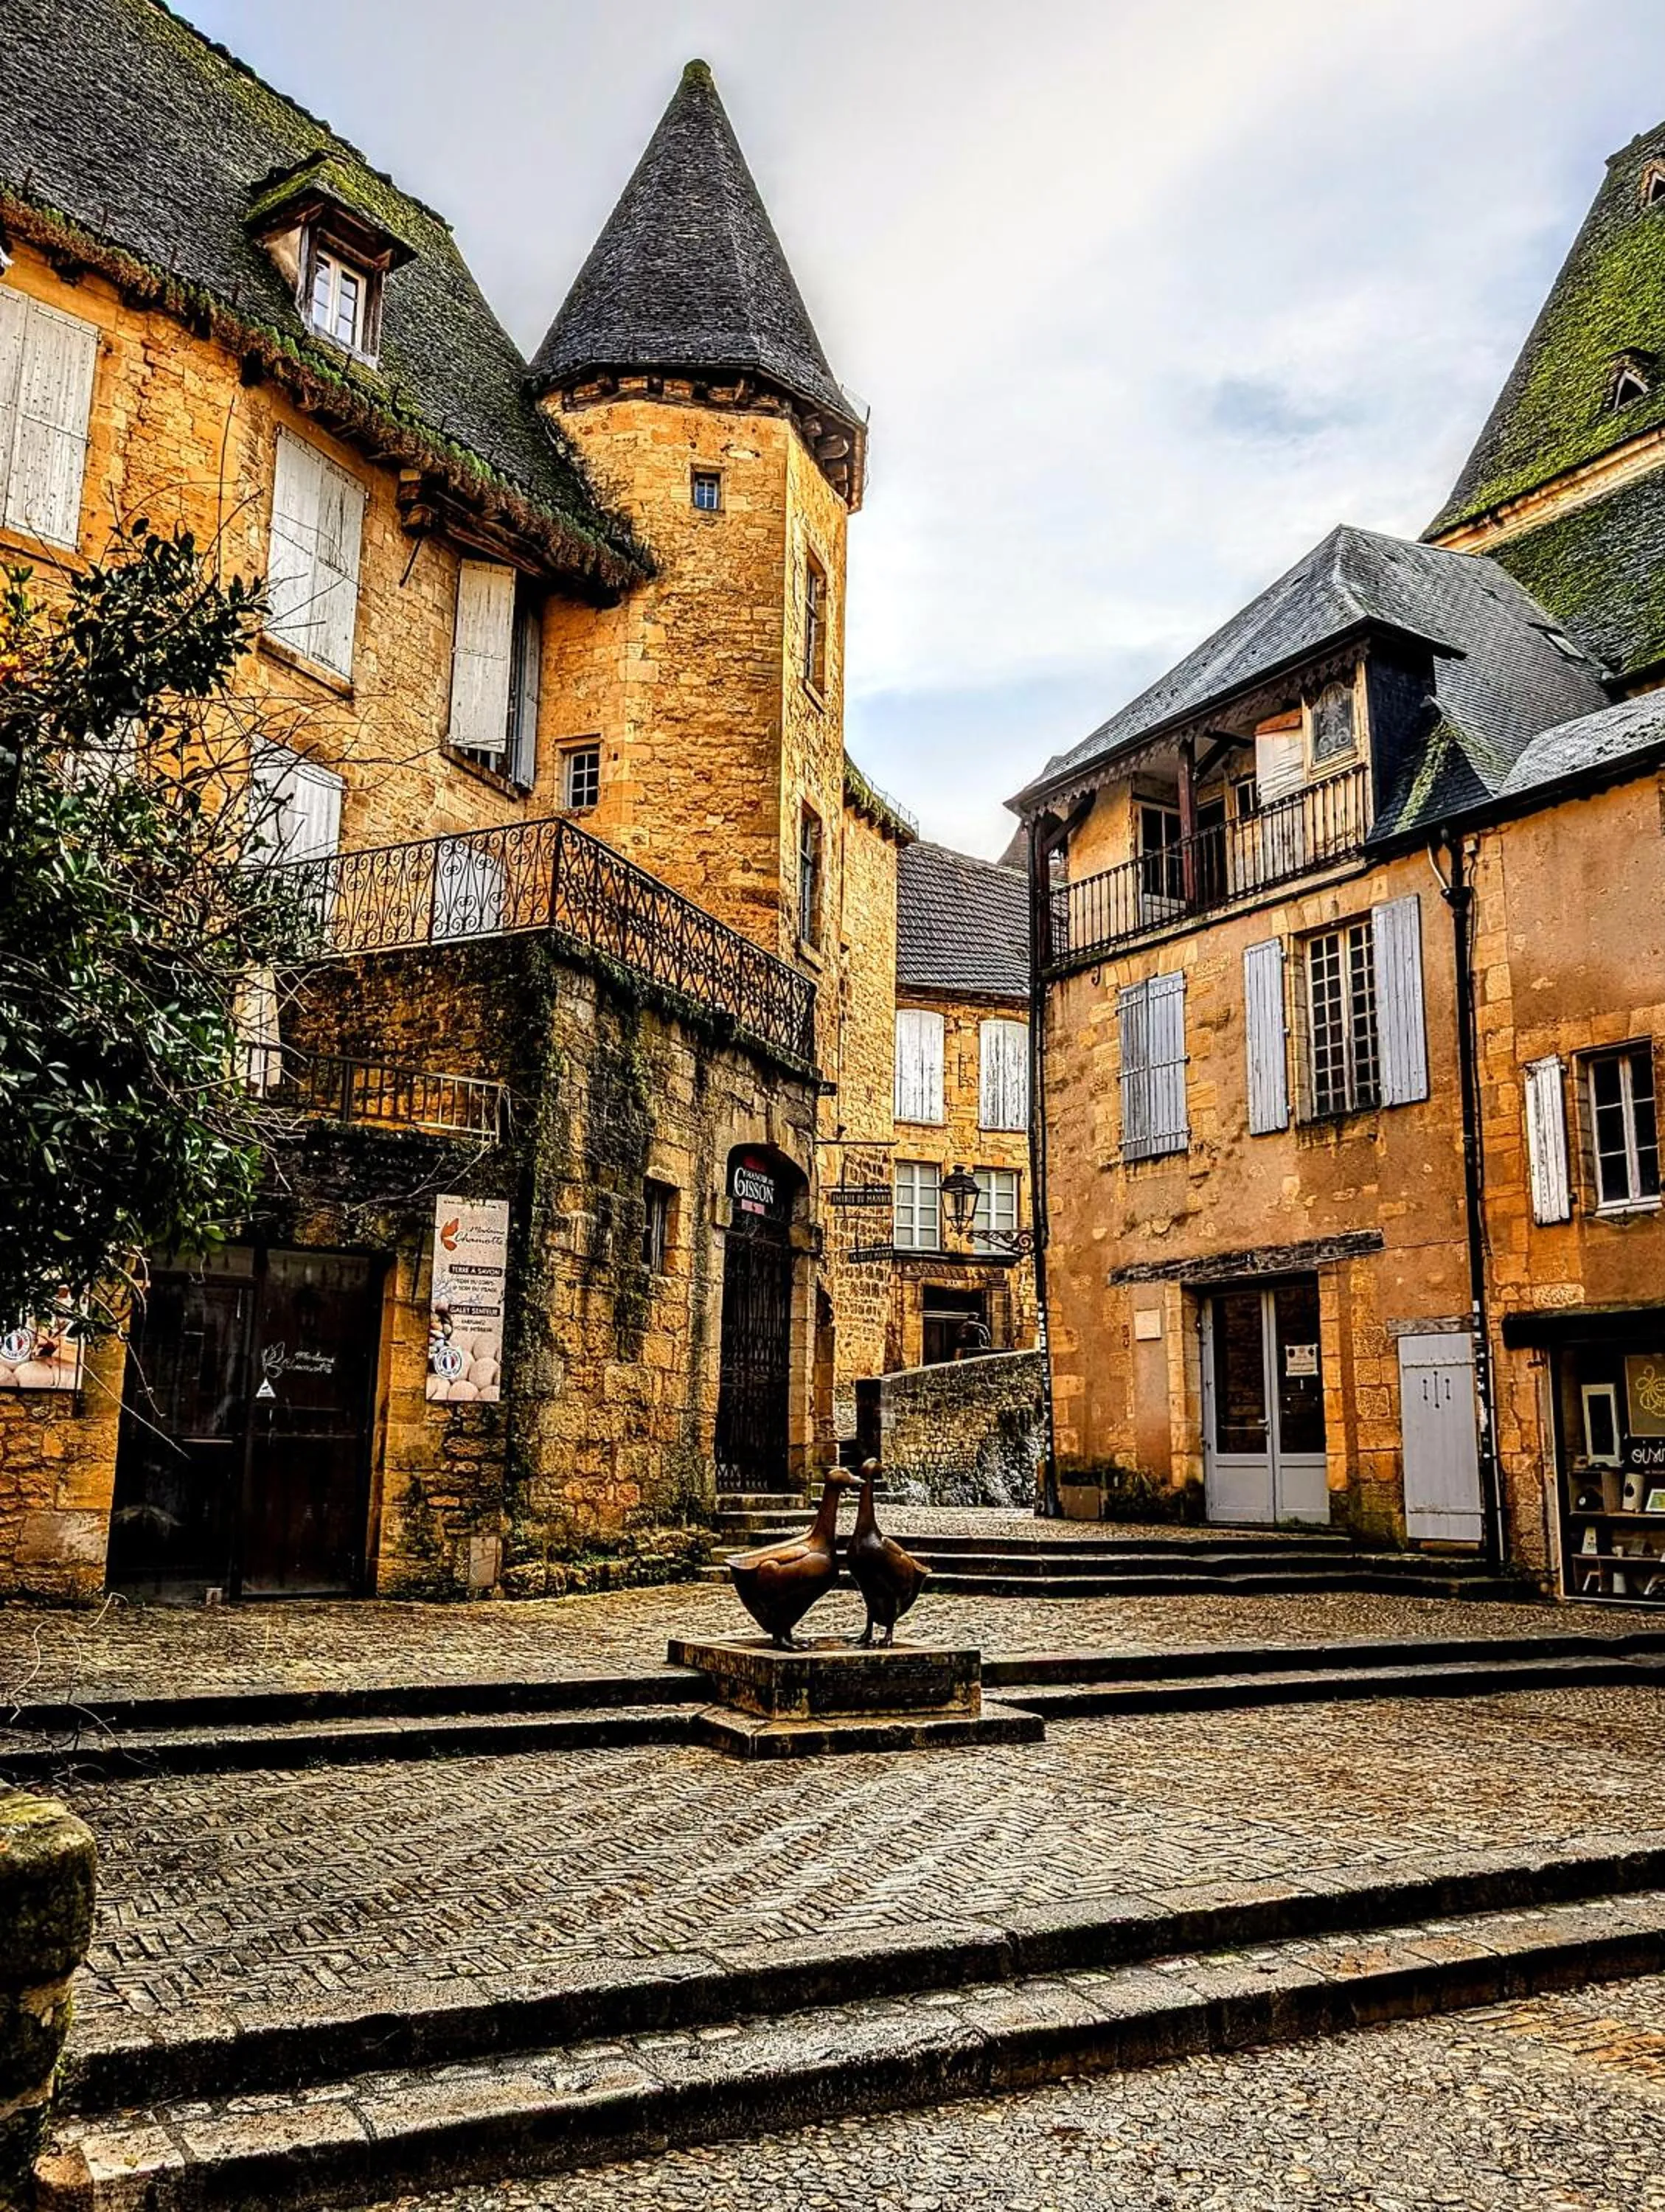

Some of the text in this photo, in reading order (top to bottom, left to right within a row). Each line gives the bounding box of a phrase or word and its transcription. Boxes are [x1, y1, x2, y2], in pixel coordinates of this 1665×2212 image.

[734, 1167, 774, 1204] GISSON
[477, 1267, 501, 1276] SAVON
[472, 1307, 498, 1315] SENTEUR
